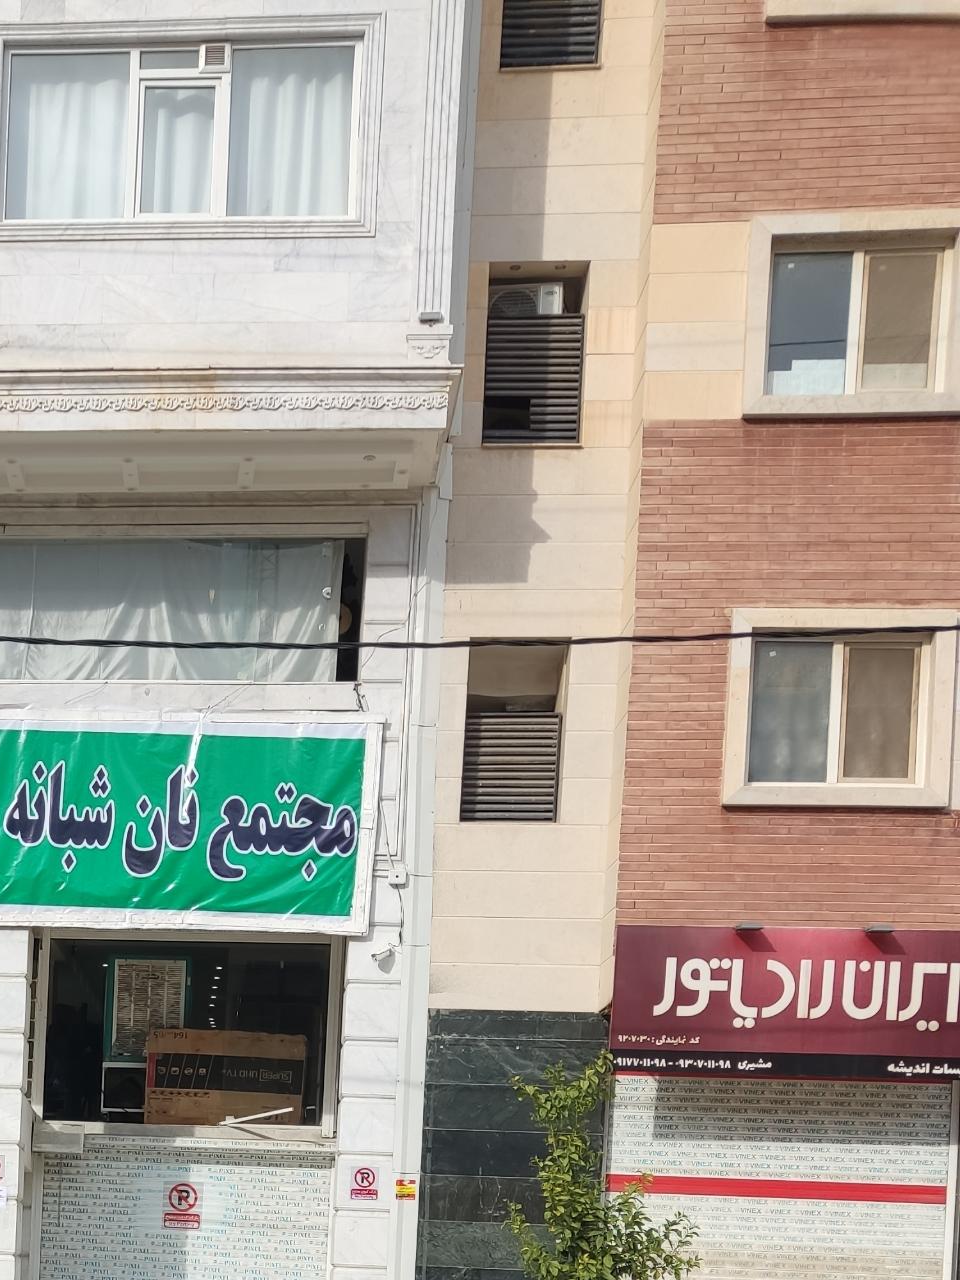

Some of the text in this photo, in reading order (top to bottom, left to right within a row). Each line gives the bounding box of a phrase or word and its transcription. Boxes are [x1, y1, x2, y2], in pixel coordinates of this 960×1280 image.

[4, 762, 115, 871] شبانه
[123, 766, 200, 877] نان
[207, 783, 358, 882] مجتمع
[652, 956, 960, 1032] ایران رادیاتور
[688, 1036, 701, 1044] کد
[737, 1058, 773, 1071] مشیری
[887, 1060, 931, 1077] اندیشه
[654, 1086, 676, 1094] VINEX
[713, 1088, 735, 1096] VINEX
[659, 1123, 680, 1131] VINEX
